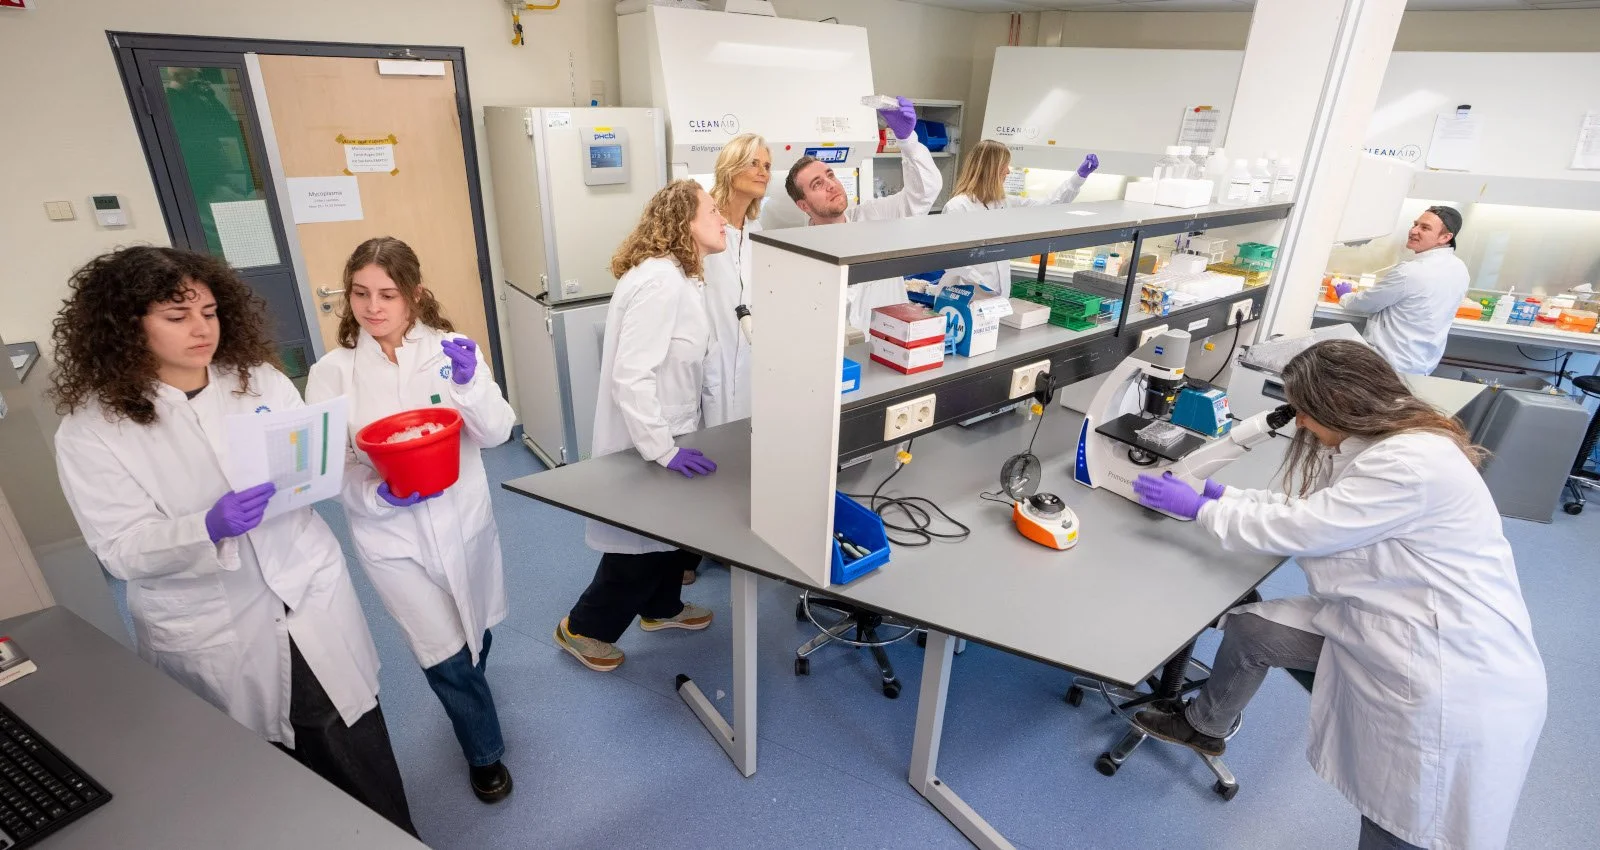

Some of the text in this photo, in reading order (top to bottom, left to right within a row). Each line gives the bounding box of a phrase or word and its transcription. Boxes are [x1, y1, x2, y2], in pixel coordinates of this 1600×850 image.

[688, 120, 736, 128] CLEANAIR
[996, 126, 1036, 134] CLEANAIR
[691, 145, 723, 153] BioVanguar
[1363, 148, 1416, 157] LEANAIR
